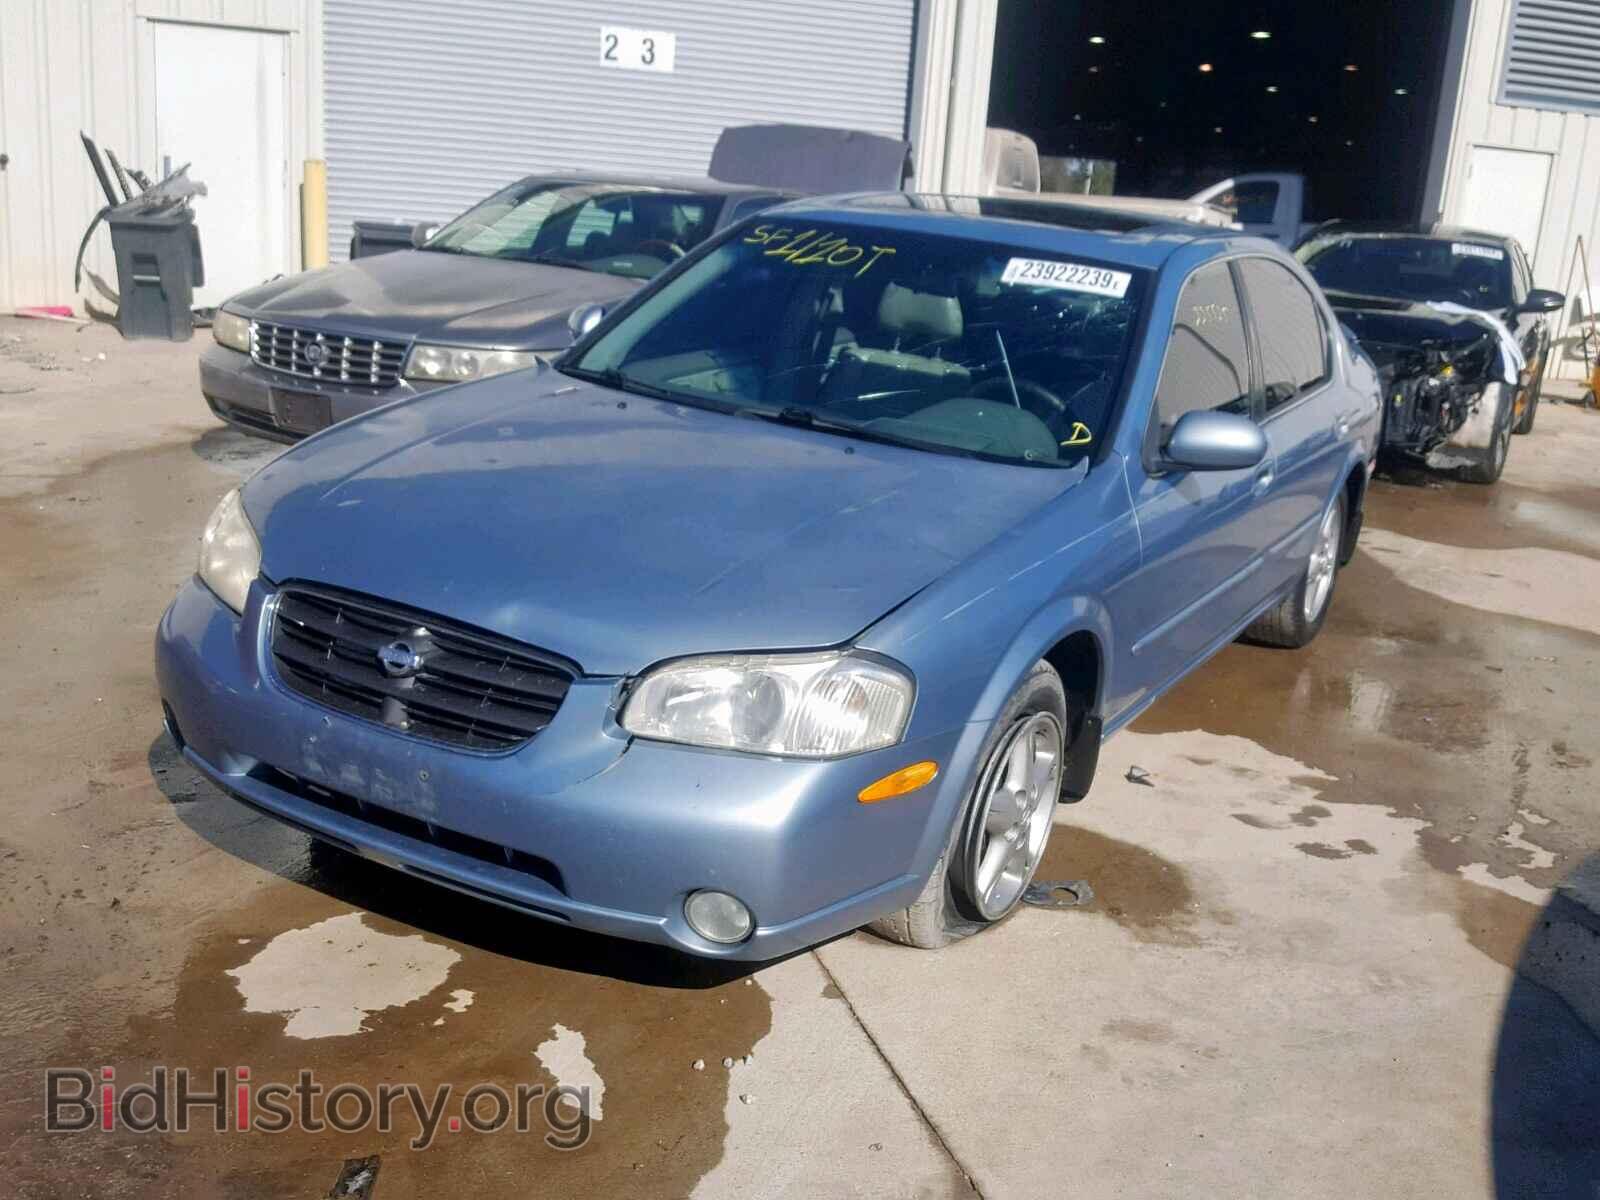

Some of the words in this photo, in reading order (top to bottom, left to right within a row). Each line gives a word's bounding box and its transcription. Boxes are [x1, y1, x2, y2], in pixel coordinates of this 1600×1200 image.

[604, 33, 618, 61] 2
[641, 37, 655, 65] 3
[1020, 261, 1113, 289] 23922239
